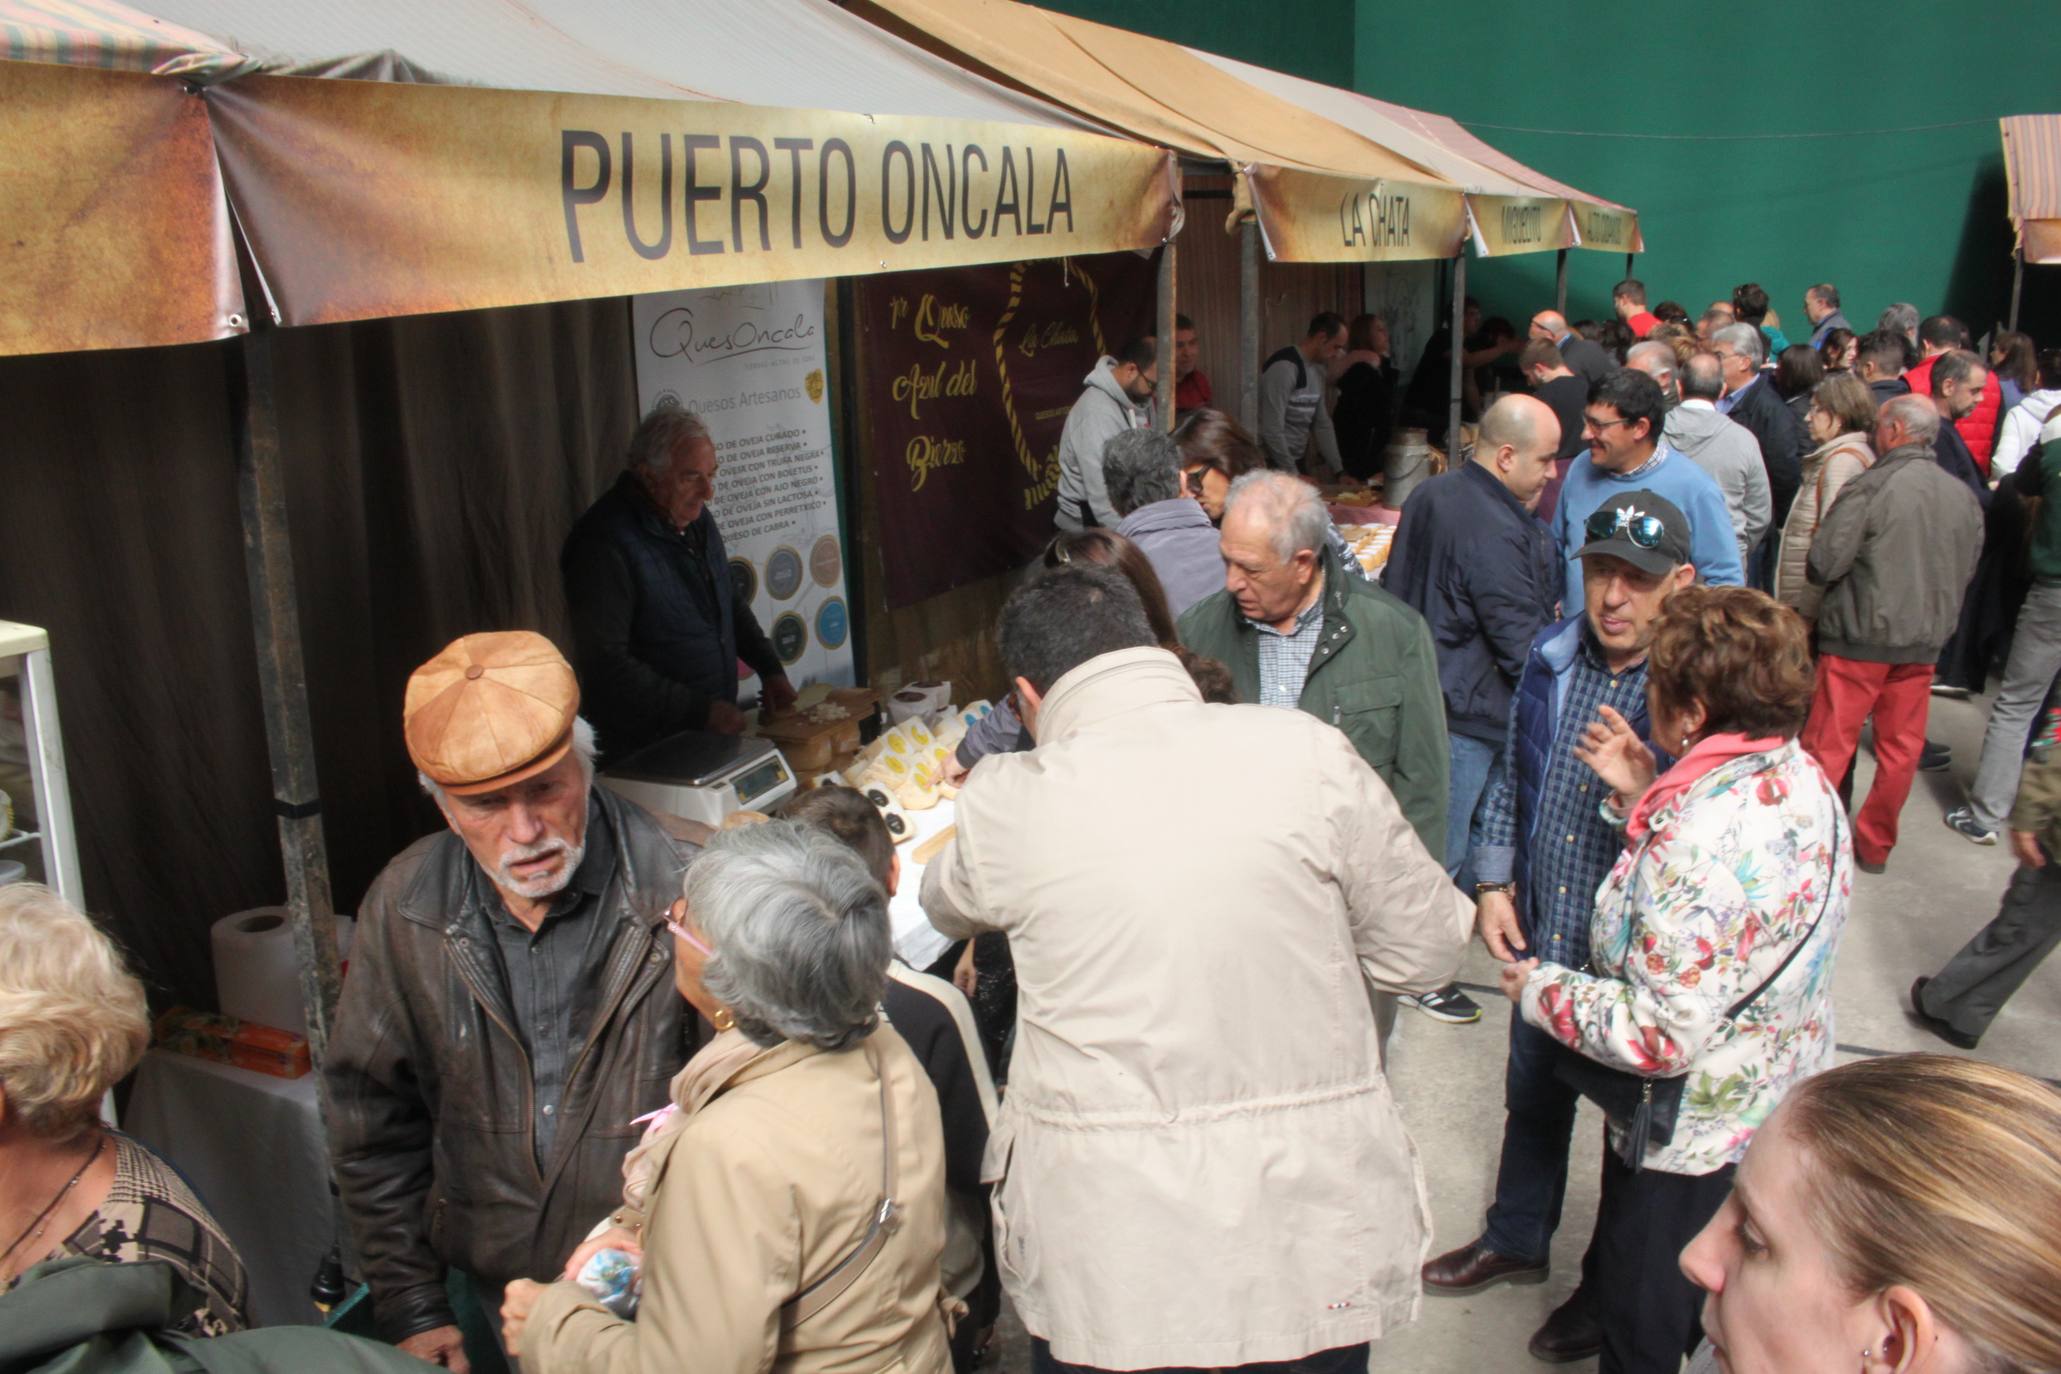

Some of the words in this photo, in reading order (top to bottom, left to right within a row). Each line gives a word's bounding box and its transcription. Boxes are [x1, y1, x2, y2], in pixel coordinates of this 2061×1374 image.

[561, 129, 857, 263] PUERTO
[881, 140, 1074, 244] ONCALA
[1340, 192, 1366, 247] LA
[1369, 192, 1409, 247] CHATA
[649, 307, 815, 364] QuesOncala
[892, 361, 946, 420] Azul
[946, 359, 977, 397] del
[688, 397, 736, 415] Quesos
[739, 386, 802, 408] Artesanos
[726, 440, 737, 449] DE
[739, 436, 763, 447] OVEJA
[727, 453, 737, 462] DE
[740, 448, 764, 460] OVEJA
[720, 465, 747, 477] OVEJA
[748, 462, 765, 472] CON
[718, 481, 728, 490] DE
[731, 477, 757, 488] OVEJA
[759, 472, 776, 481] CON
[714, 495, 726, 504] DE
[727, 490, 753, 502] OVEJA
[755, 486, 772, 496] CON
[722, 506, 733, 516] DE
[736, 502, 761, 513] OVEJA
[777, 490, 812, 504] LACTOSA
[728, 516, 753, 528] OVEJA
[756, 511, 773, 521] CON
[751, 527, 762, 536] DE
[763, 520, 790, 533] CABRA
